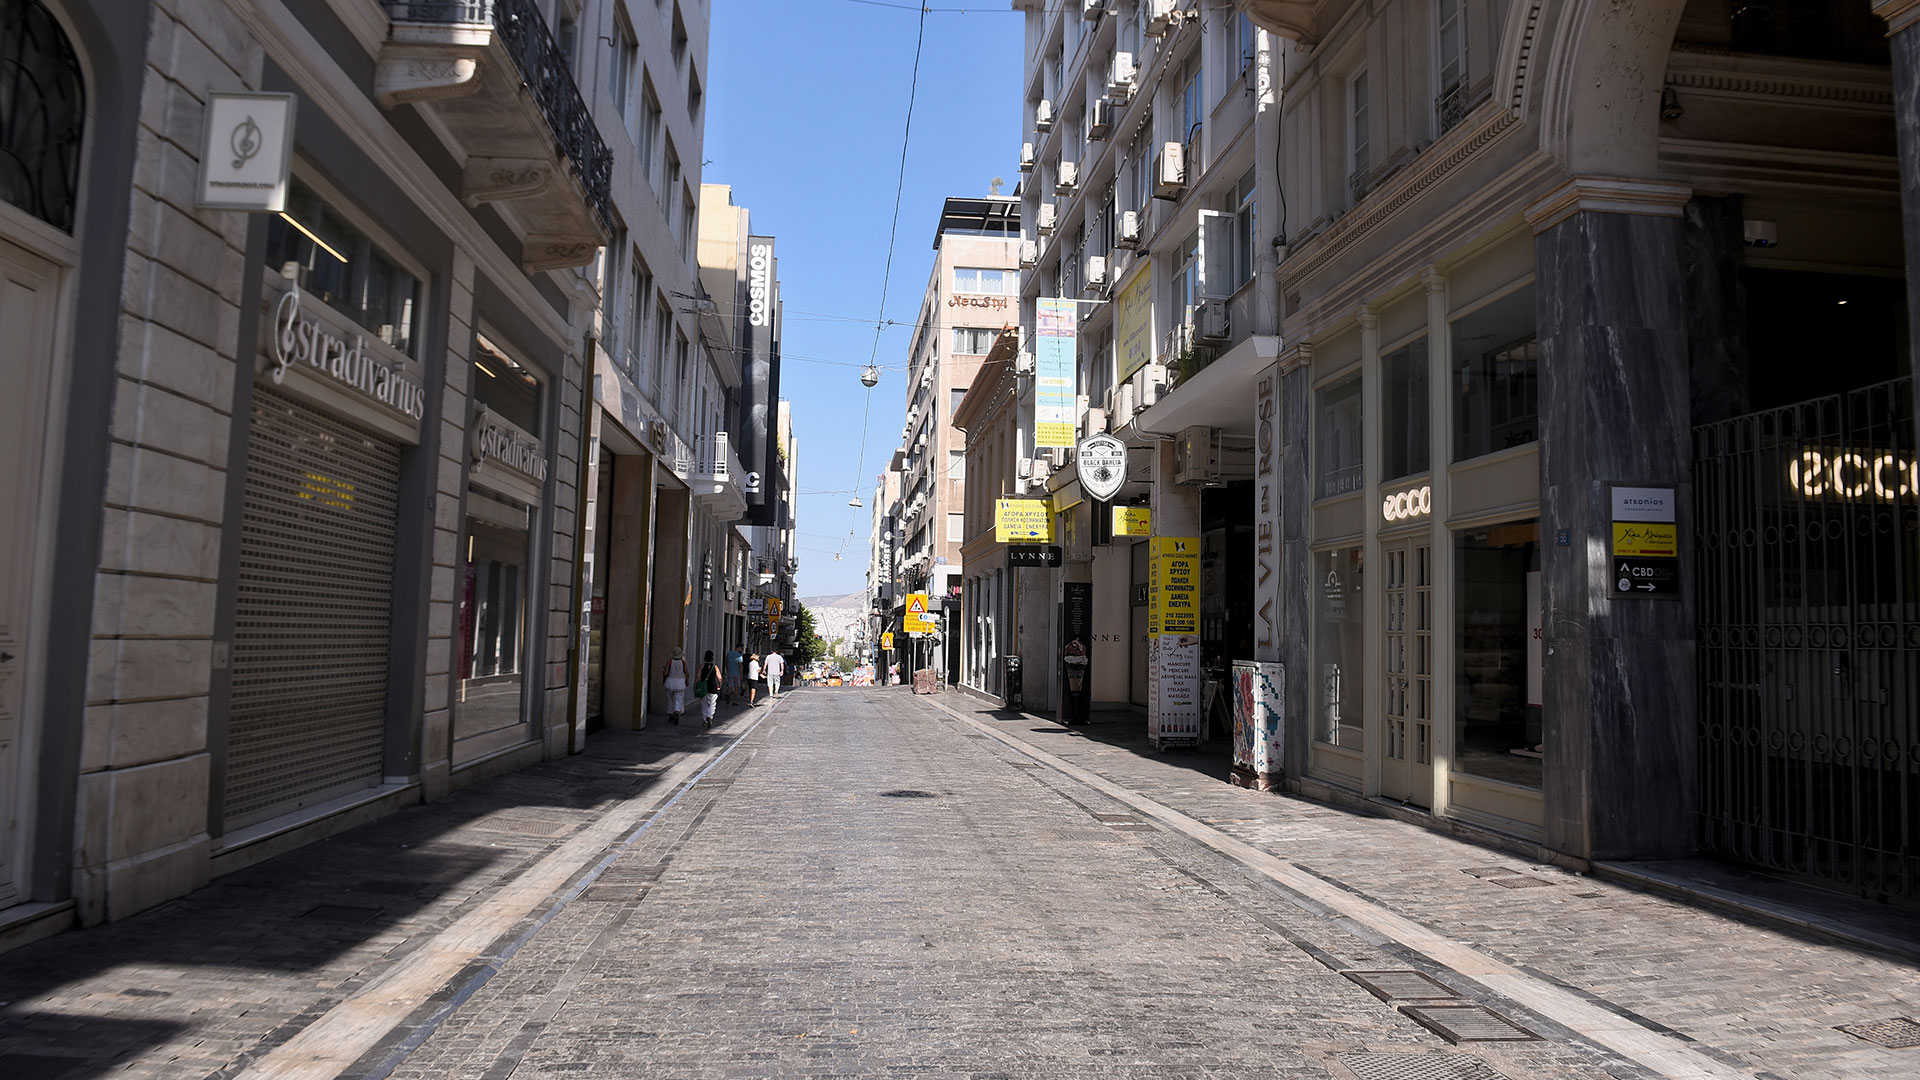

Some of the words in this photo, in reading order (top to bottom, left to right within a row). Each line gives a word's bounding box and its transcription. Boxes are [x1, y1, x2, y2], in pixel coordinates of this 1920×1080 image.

[749, 244, 766, 327] COSMOS
[296, 319, 425, 421] stradivarius
[1258, 375, 1273, 480] ROSE
[486, 427, 548, 482] stradivarius
[1790, 451, 1920, 499] ecc
[1261, 485, 1270, 514] EN
[1383, 486, 1431, 521] ecco
[1623, 497, 1664, 506] atsonios
[1010, 552, 1055, 560] LYNNE
[1258, 520, 1272, 589] VIE
[1258, 596, 1272, 649] LA
